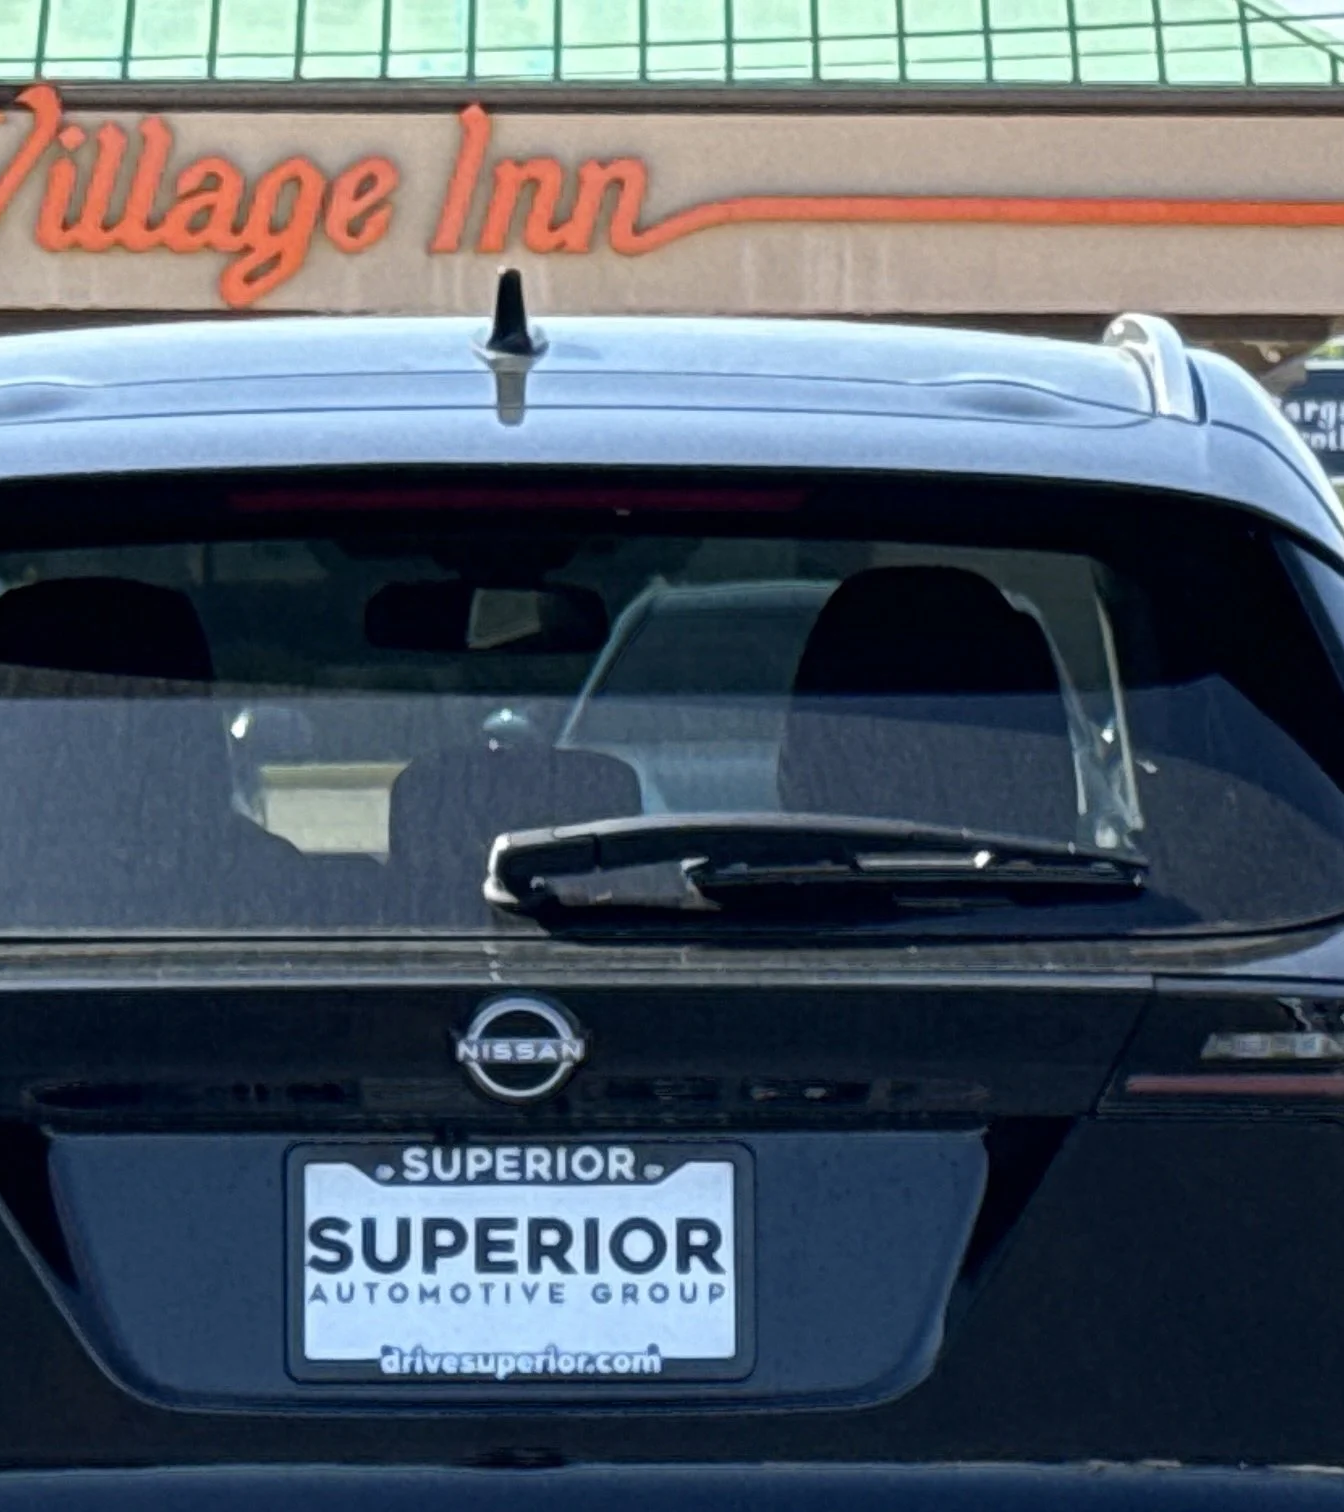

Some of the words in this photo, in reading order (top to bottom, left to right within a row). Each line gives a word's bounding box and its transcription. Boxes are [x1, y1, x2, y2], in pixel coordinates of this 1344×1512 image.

[427, 103, 648, 254] Inn
[457, 1039, 582, 1061] NISSAN
[401, 1146, 636, 1182] SUPERIOR
[307, 1216, 726, 1275] SUPERIOR
[308, 1282, 566, 1305] AUTOMOTIVE
[591, 1282, 725, 1305] GROUP
[380, 1344, 662, 1380] drivesuperior.com
